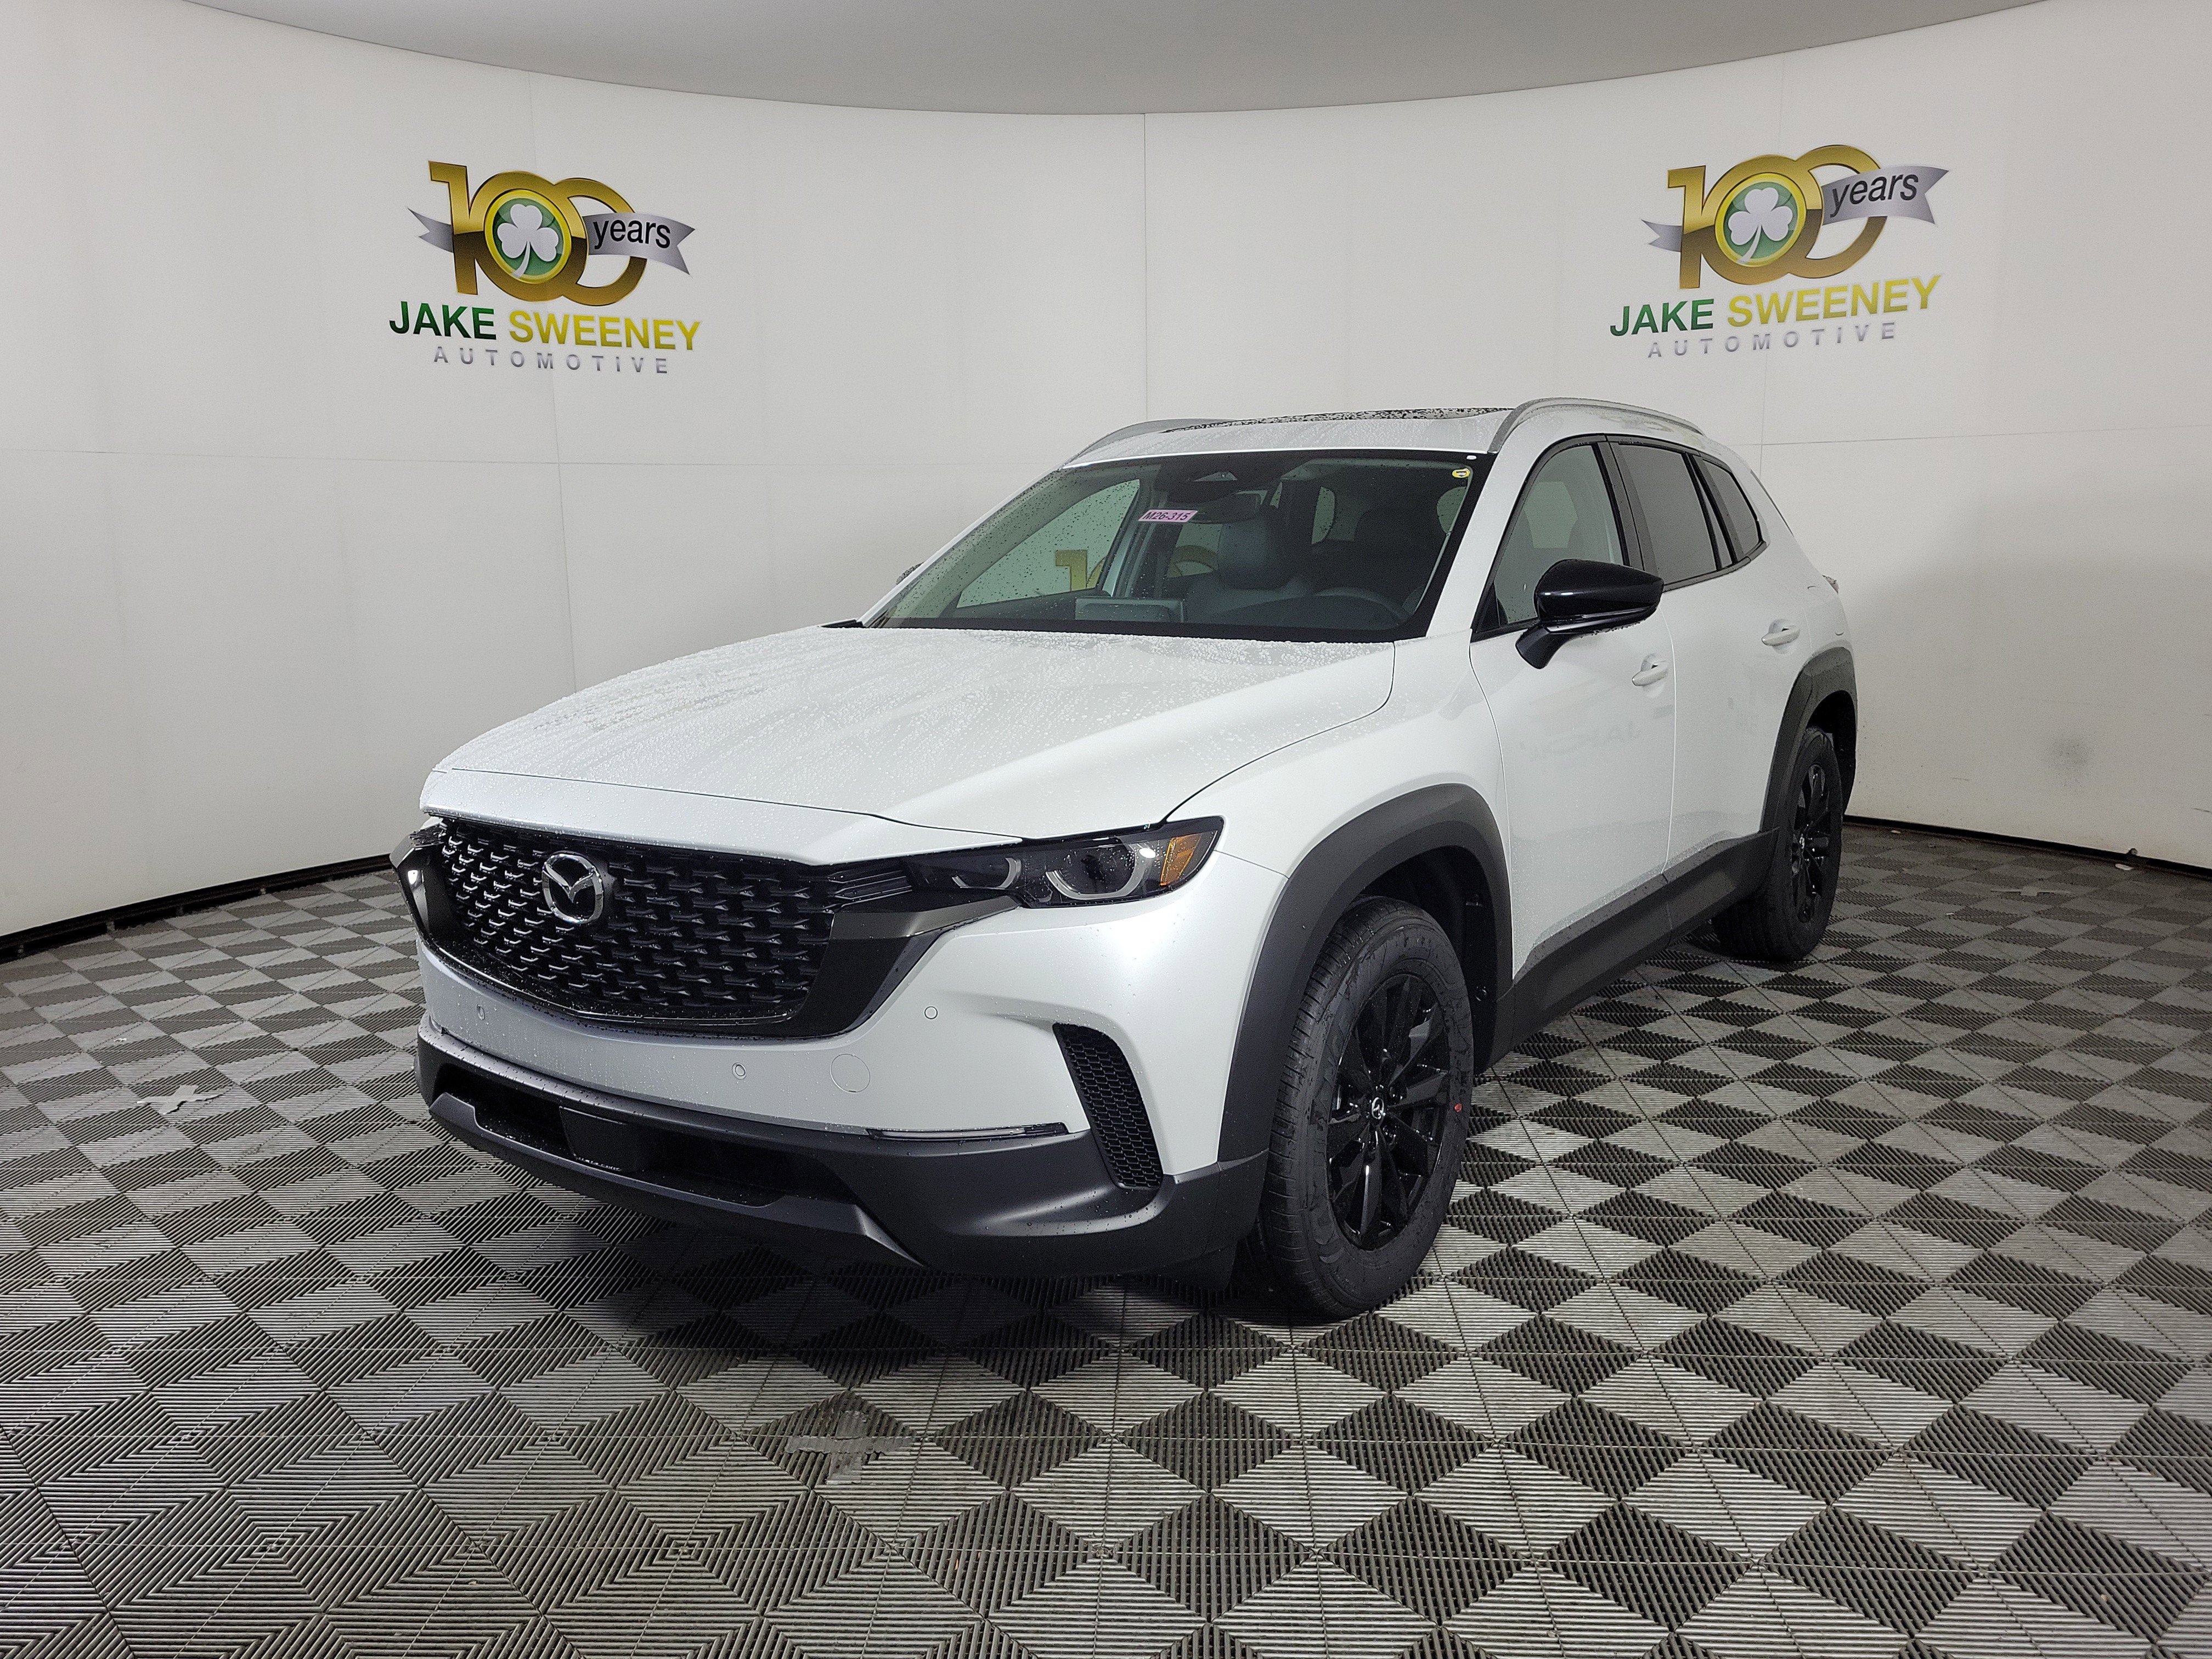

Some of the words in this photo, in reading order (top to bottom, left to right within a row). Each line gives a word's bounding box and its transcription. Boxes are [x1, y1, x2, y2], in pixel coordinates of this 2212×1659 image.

[427, 160, 648, 306] 100
[592, 219, 670, 250] years
[1668, 144, 1888, 289] 100
[1830, 173, 1919, 218] years
[389, 300, 497, 340] JAKE
[509, 310, 701, 351] SWEENEY
[1610, 298, 1715, 337] JAKE
[1727, 275, 1942, 328] SWEENEY
[433, 346, 668, 374] AUTOMOTIVE
[1647, 321, 1896, 358] AUTOMOTIVE
[1142, 512, 1191, 521] M26-315
